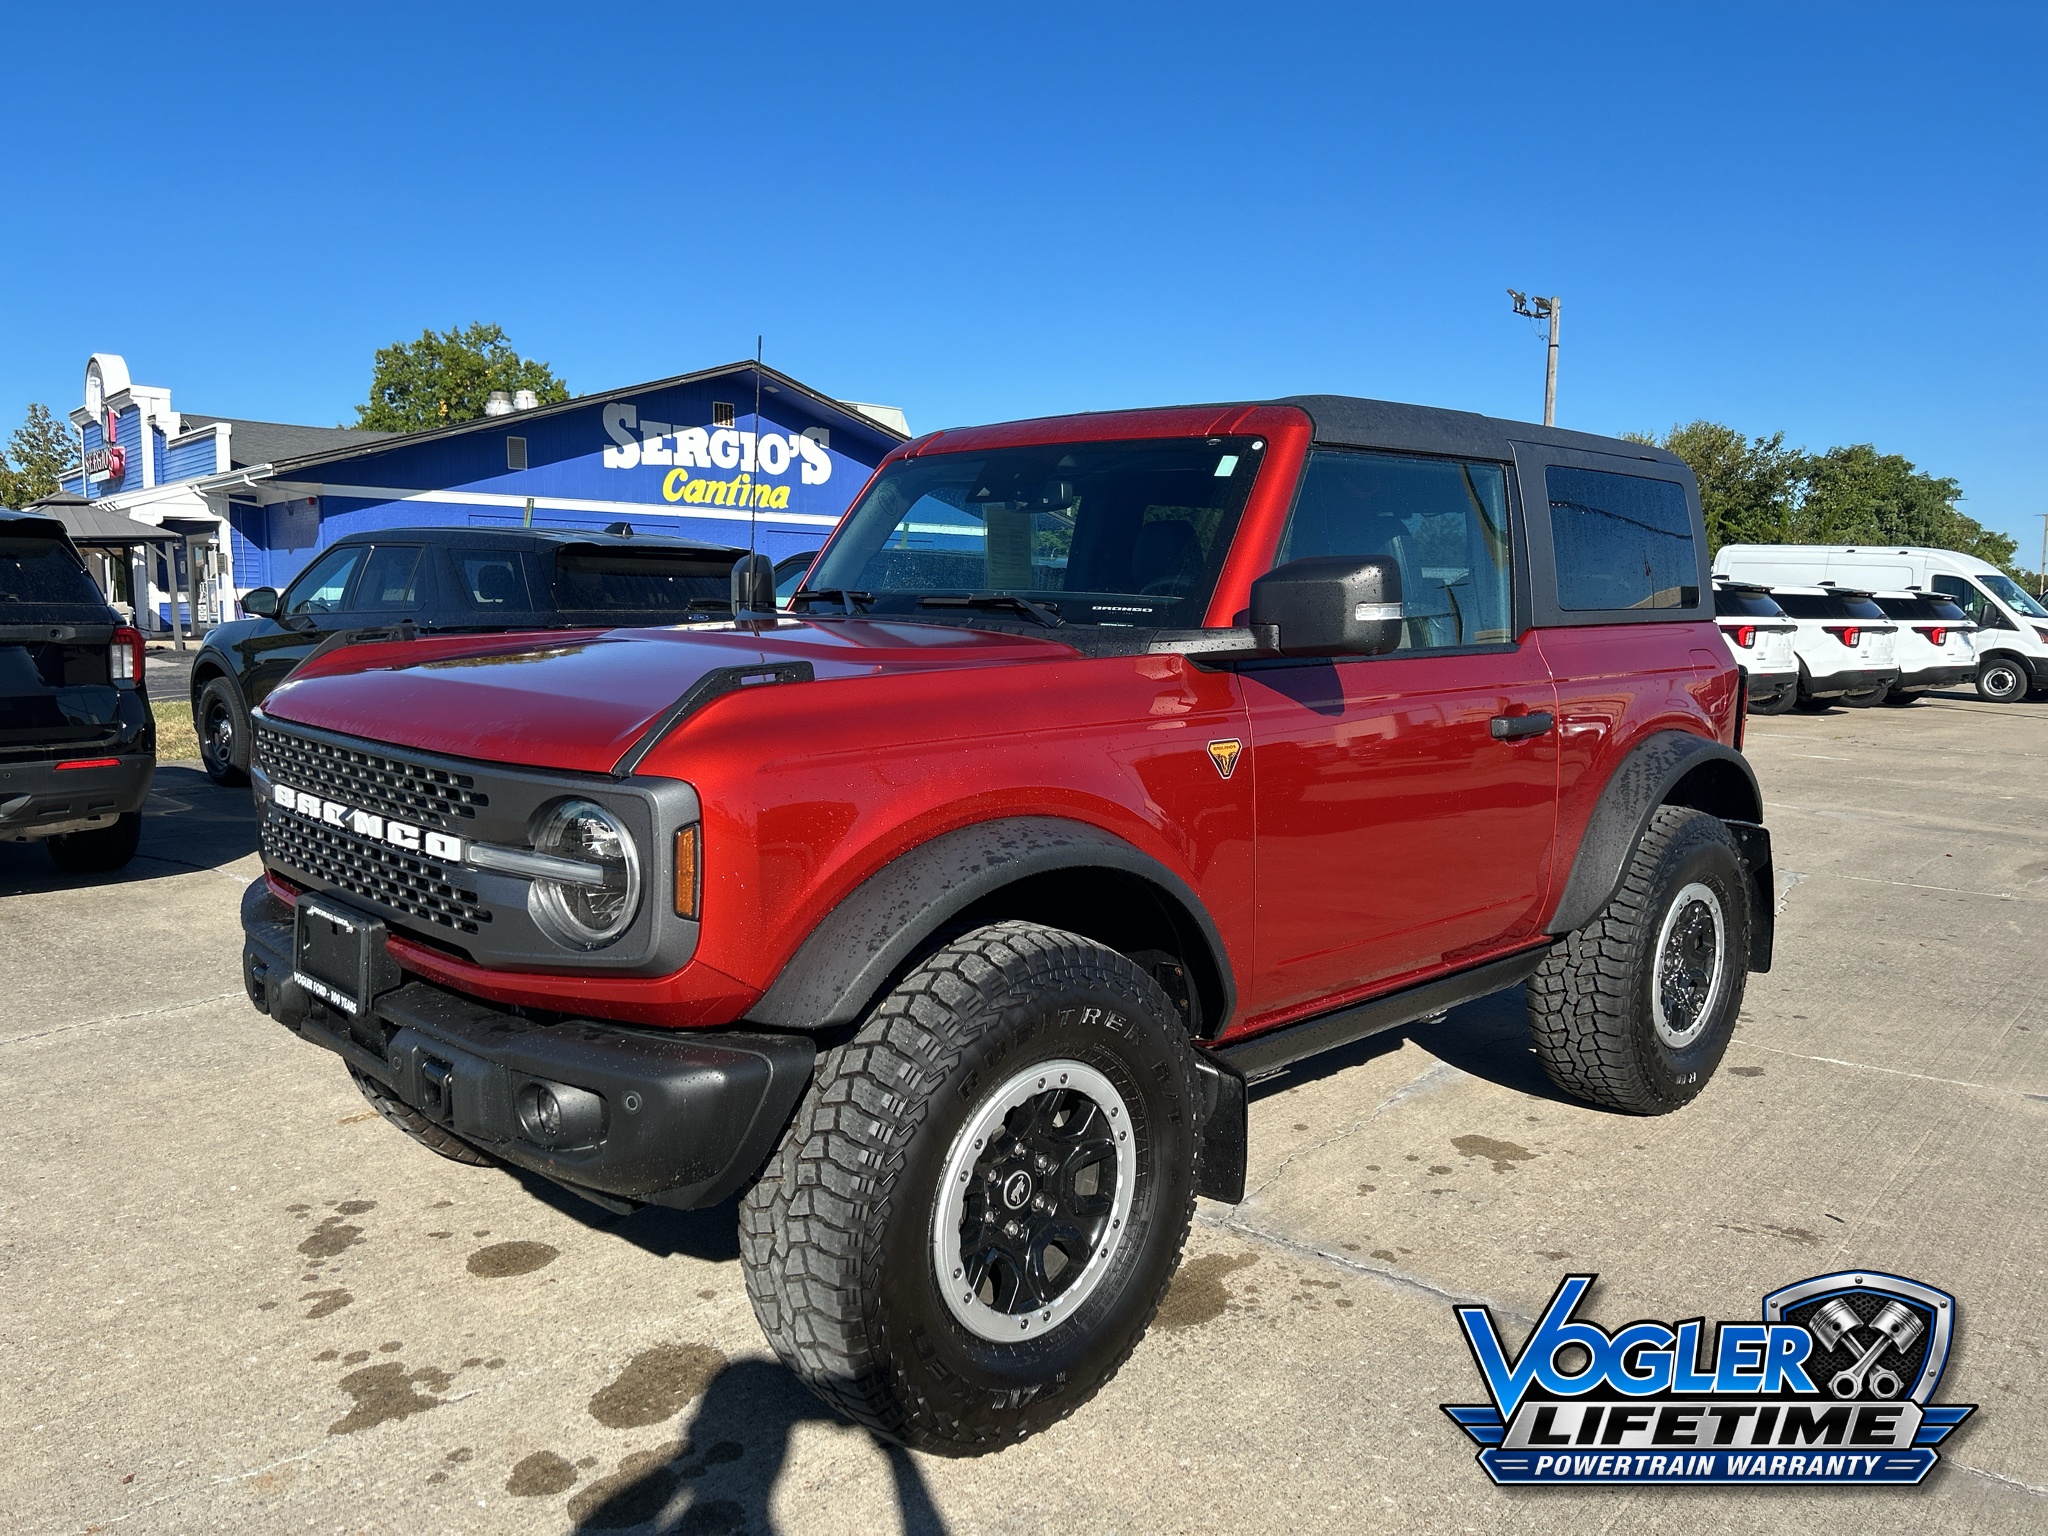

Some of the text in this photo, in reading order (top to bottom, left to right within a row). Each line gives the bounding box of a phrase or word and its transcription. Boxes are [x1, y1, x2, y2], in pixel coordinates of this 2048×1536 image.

[603, 403, 833, 485] SERGIO'S
[662, 468, 791, 509] Cantina
[1092, 605, 1153, 613] BRONCO
[274, 784, 462, 862] BRONCO
[293, 971, 313, 991] VOGLER
[312, 981, 327, 997] FORD
[340, 995, 357, 1014] YEARS
